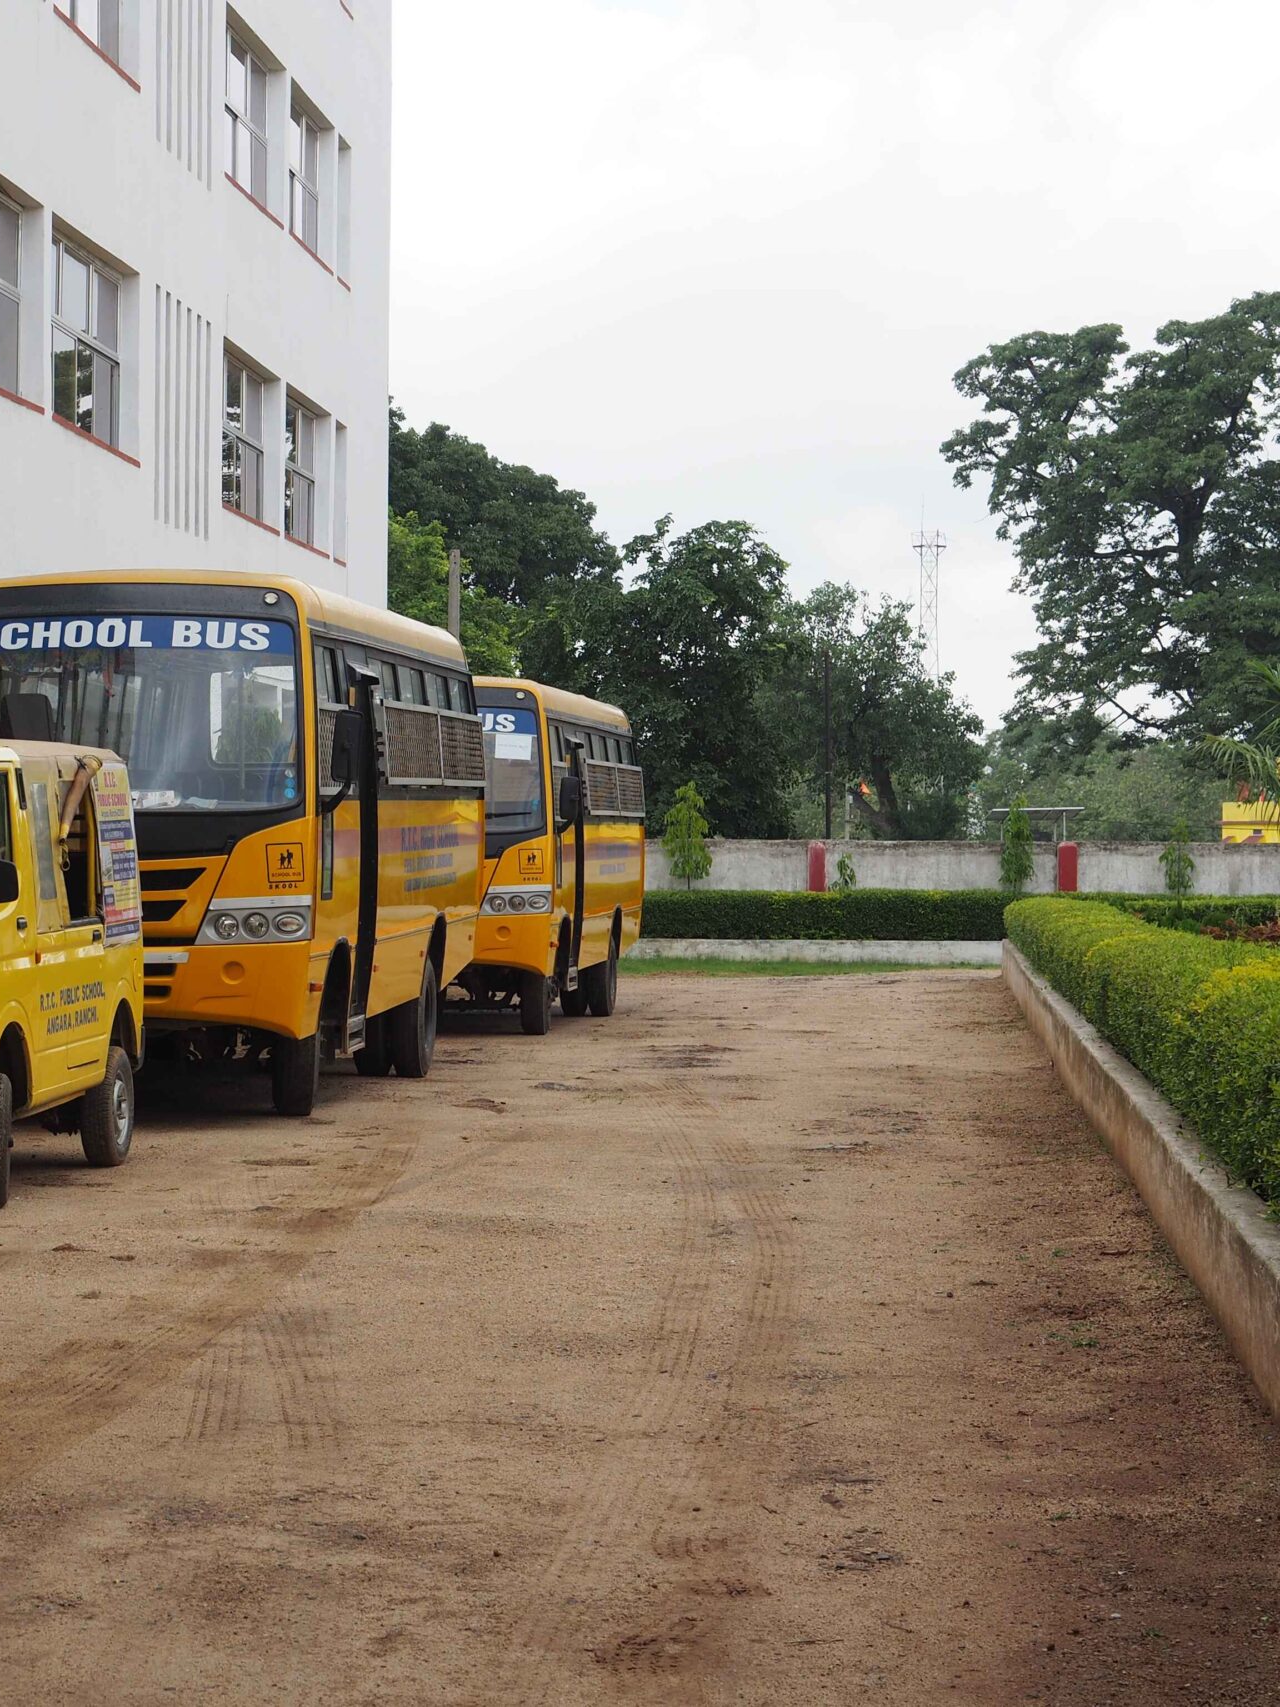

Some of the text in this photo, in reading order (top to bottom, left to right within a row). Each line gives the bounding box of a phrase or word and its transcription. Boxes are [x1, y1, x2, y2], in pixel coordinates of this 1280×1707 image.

[172, 620, 270, 650] BUS
[40, 992, 58, 1012] R.T.C.
[60, 985, 80, 1007] PUBLIC
